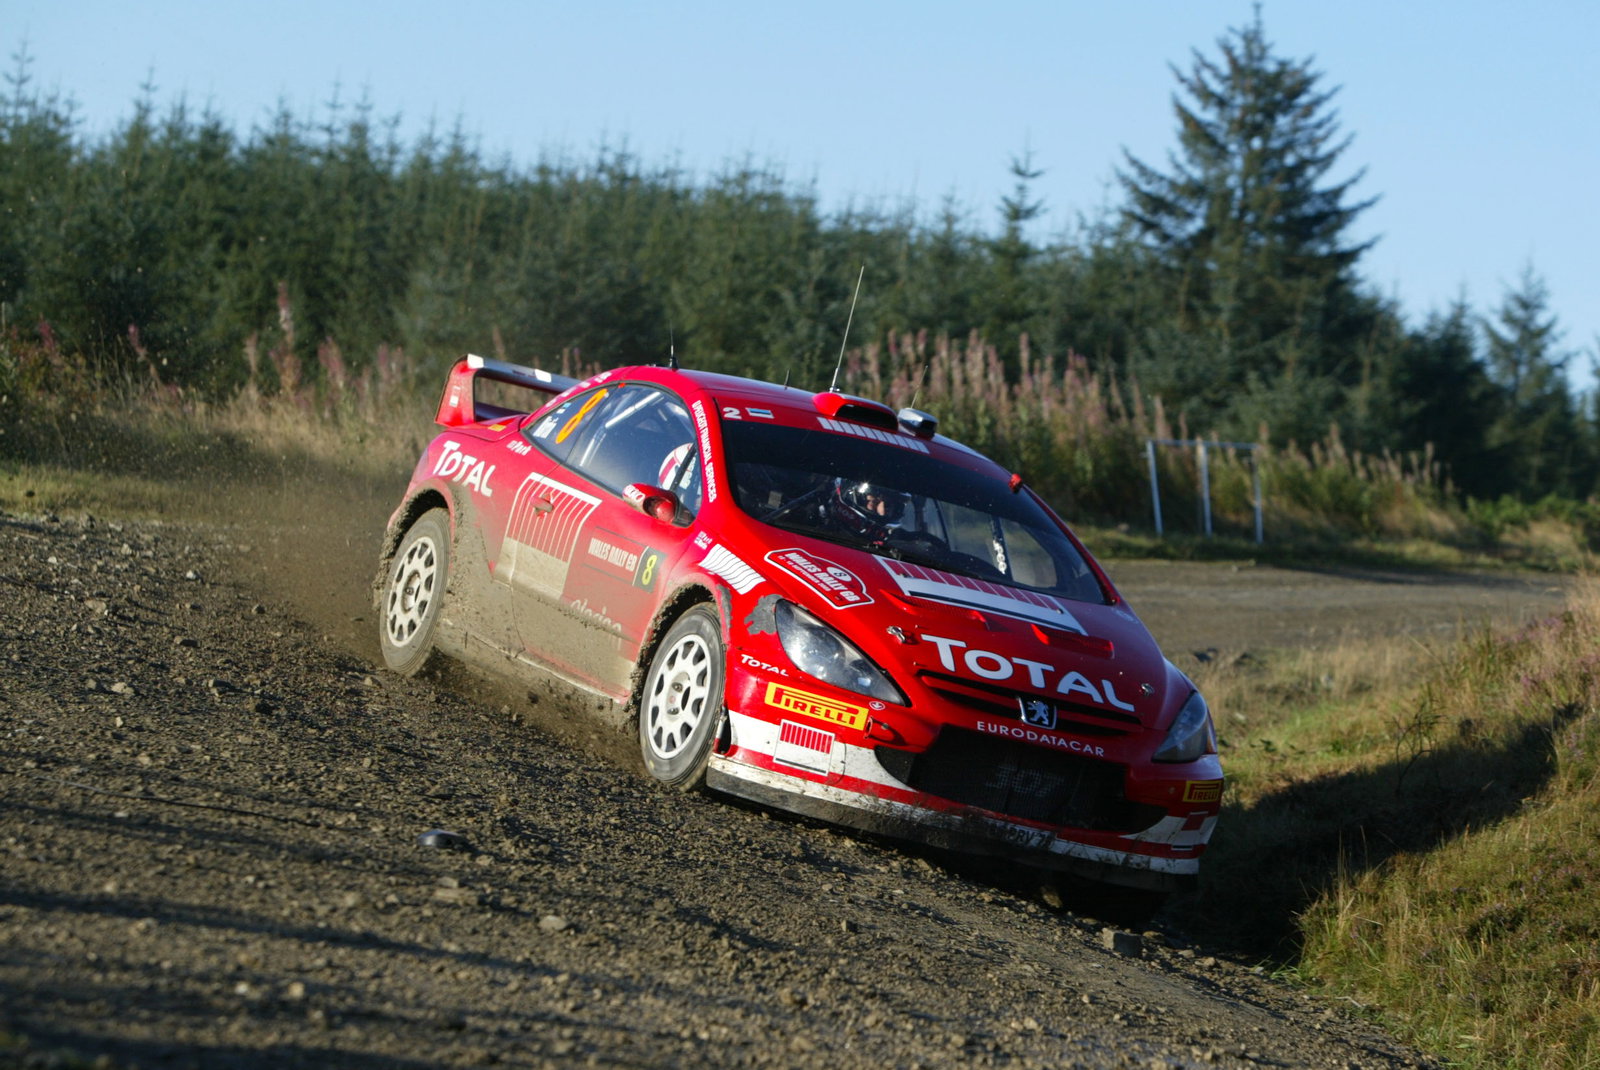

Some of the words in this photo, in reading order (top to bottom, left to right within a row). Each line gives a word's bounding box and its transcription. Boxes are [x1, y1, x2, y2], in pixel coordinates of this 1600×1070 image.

[723, 407, 742, 419] 2
[699, 426, 712, 465] FINANCIAL
[433, 440, 496, 497] TOTAL
[705, 461, 717, 503] SERVICES
[587, 537, 611, 560] WALES
[607, 543, 629, 567] RALLY
[625, 553, 638, 572] GB
[641, 554, 657, 586] 8
[784, 552, 822, 573] WALES
[814, 572, 848, 590] RALLY
[839, 591, 860, 602] GB
[740, 653, 789, 677] TOTAL
[921, 633, 1135, 712] TOTAL
[772, 686, 860, 726] PIRELLI
[976, 720, 1104, 757] EURODATACAR
[1186, 783, 1220, 801] PIRELLI
